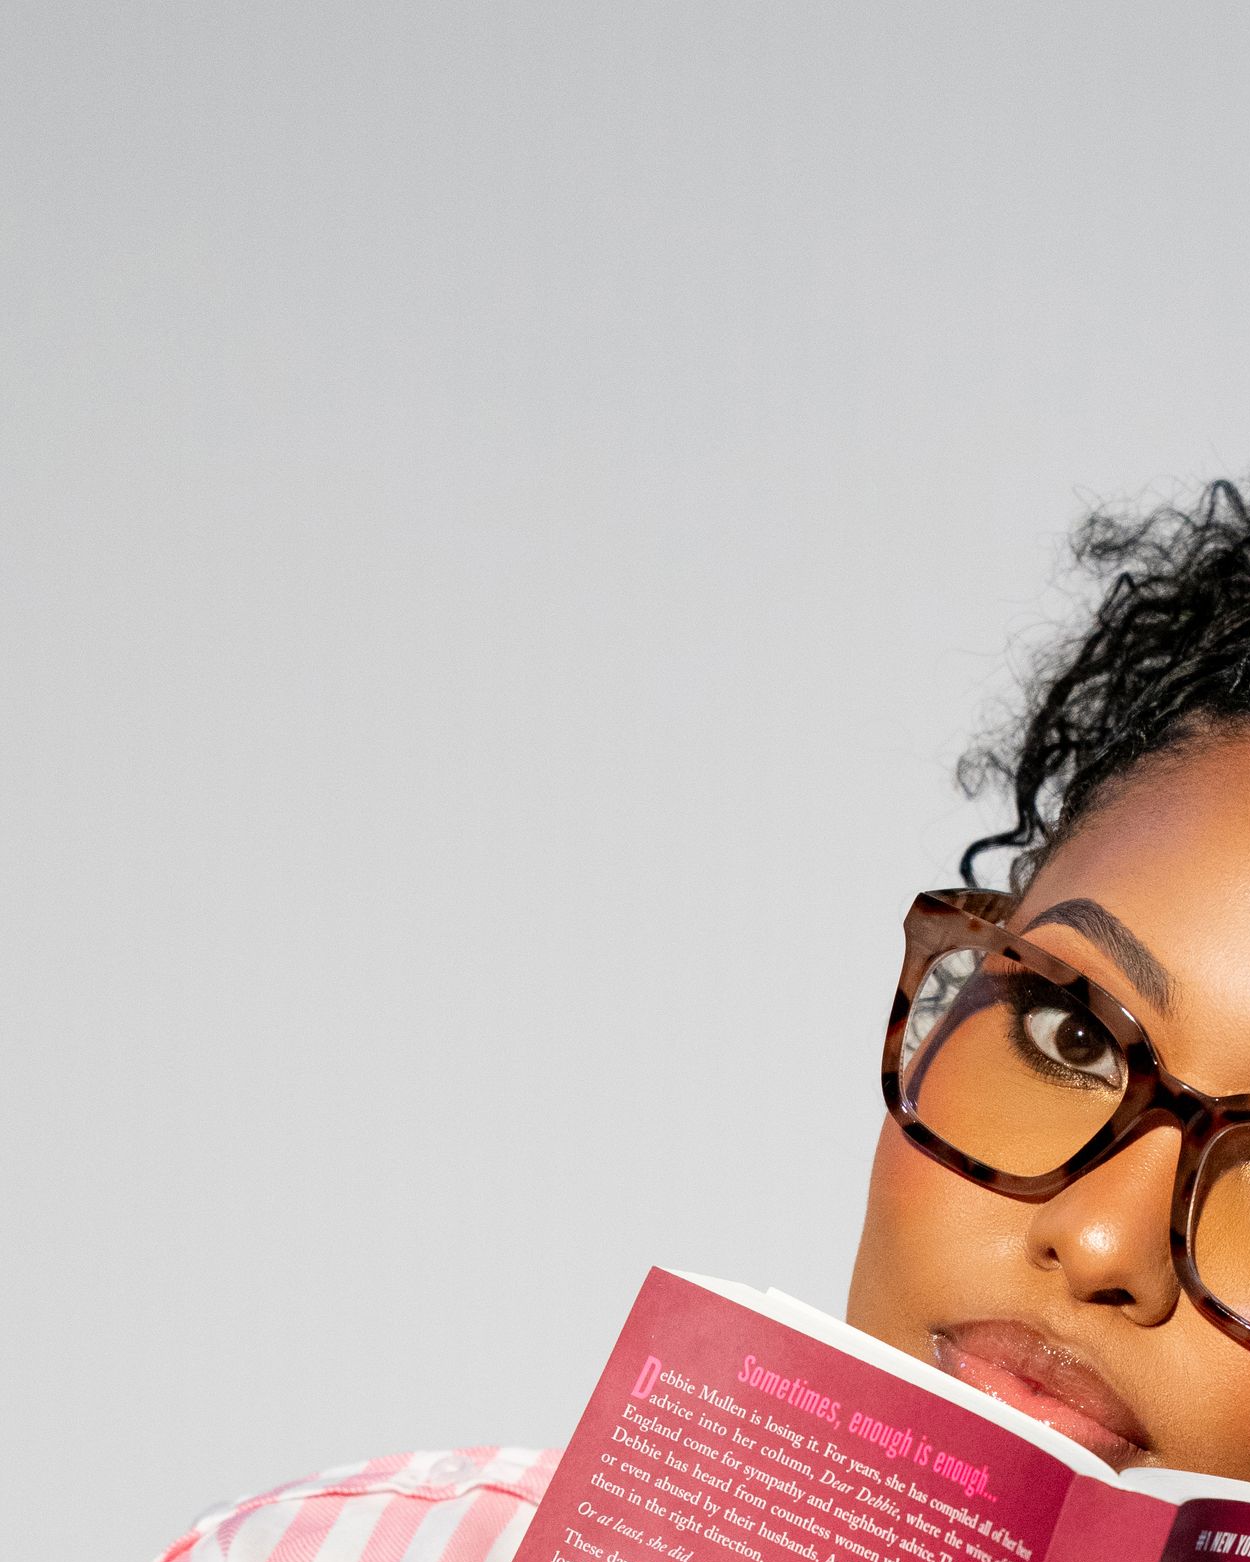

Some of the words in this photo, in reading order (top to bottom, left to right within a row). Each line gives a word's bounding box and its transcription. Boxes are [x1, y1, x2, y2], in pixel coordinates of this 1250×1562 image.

[611, 1425, 662, 1460] Debbie
[691, 1463, 733, 1493] heard
[733, 1484, 767, 1510] from
[770, 1505, 831, 1540] countless
[834, 1534, 879, 1562] women
[622, 1403, 682, 1442] England
[683, 1437, 719, 1460] come
[743, 1465, 806, 1503] sympathy
[833, 1507, 899, 1547] neighborly
[630, 1356, 695, 1400] Debbie
[698, 1384, 746, 1419] Mullen
[764, 1415, 805, 1448] losing
[845, 1459, 882, 1484] years,
[929, 1498, 979, 1529] compiled
[648, 1394, 693, 1420] advice
[760, 1446, 814, 1480] column,
[818, 1469, 854, 1494] Dear
[855, 1486, 901, 1521] Debbie,
[906, 1513, 941, 1538] where
[737, 1354, 841, 1430] Sometimes,
[848, 1411, 913, 1458] enough
[913, 1435, 932, 1466] is
[933, 1451, 996, 1502] enough...
[564, 1527, 603, 1558] These
[590, 1472, 625, 1498] them
[668, 1510, 703, 1534] right
[654, 1476, 702, 1505] abused
[723, 1507, 756, 1531] their
[757, 1521, 819, 1562] husbands.
[1196, 1530, 1211, 1551] #1
[1211, 1531, 1235, 1555] NEW
